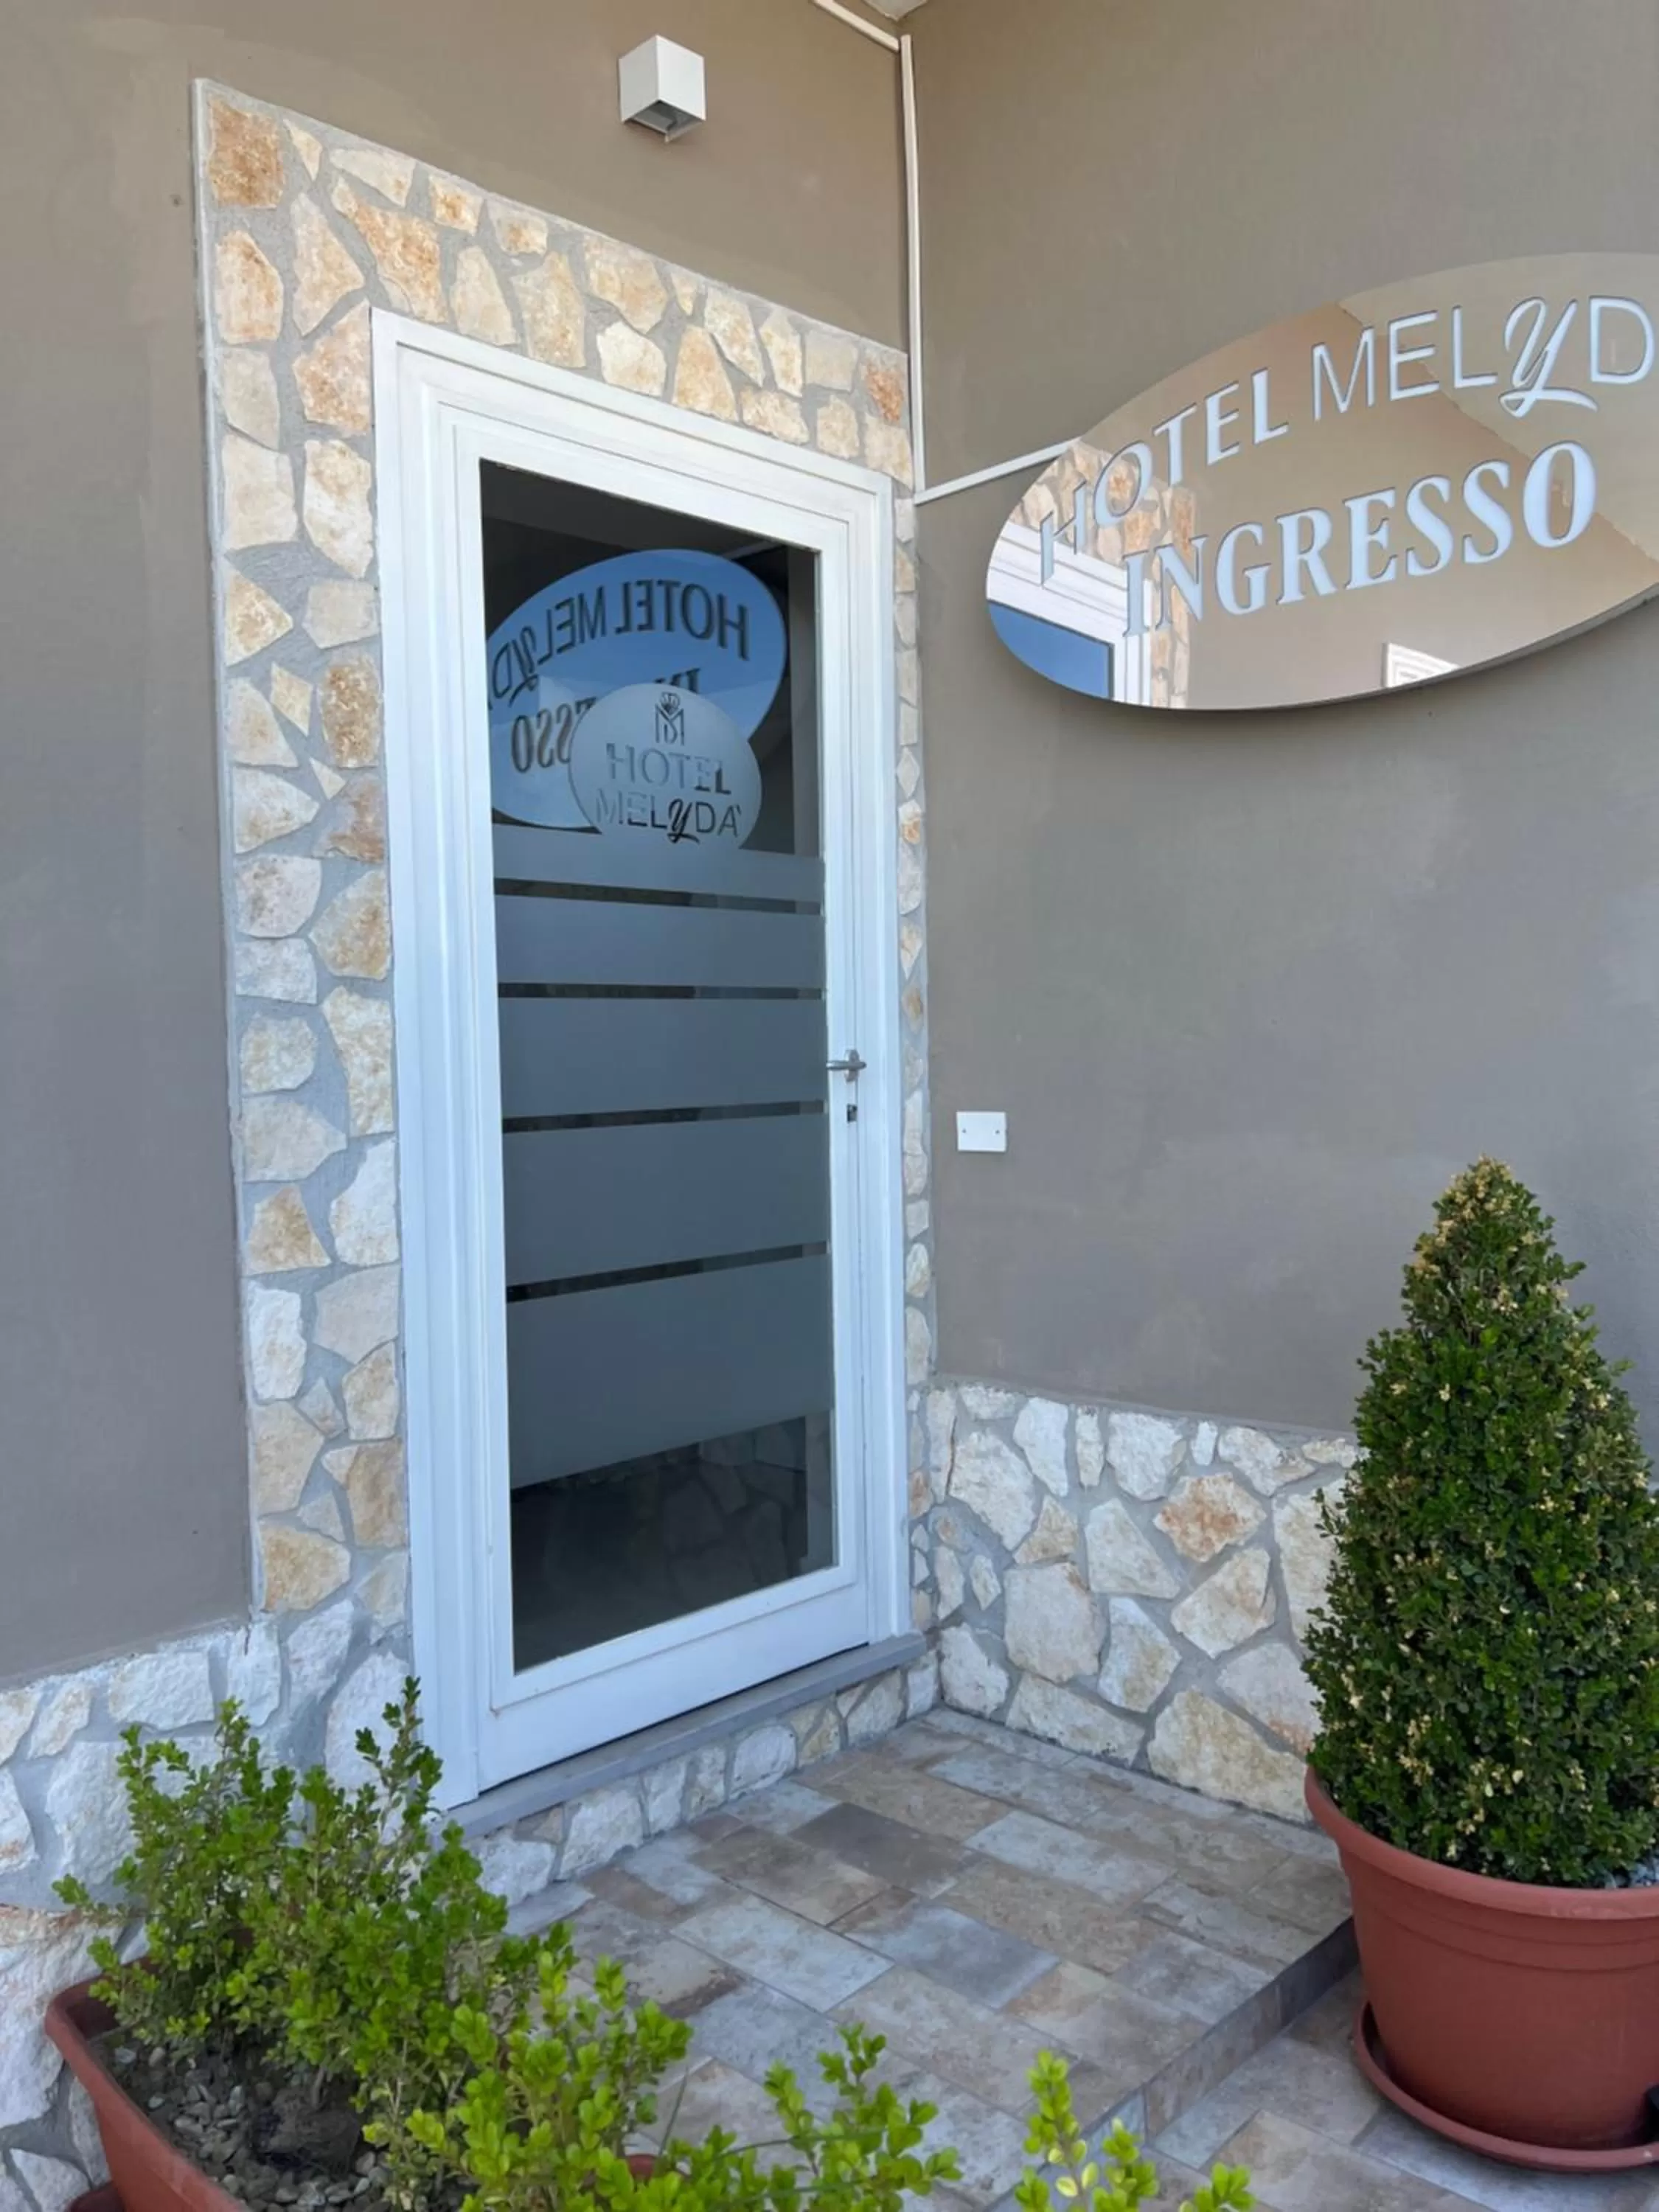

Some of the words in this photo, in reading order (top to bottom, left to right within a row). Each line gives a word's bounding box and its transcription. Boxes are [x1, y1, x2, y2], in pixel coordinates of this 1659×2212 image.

[1039, 367, 1290, 587] HOTEL
[1122, 439, 1597, 639] INGRESSO
[605, 742, 732, 795] HOTEL
